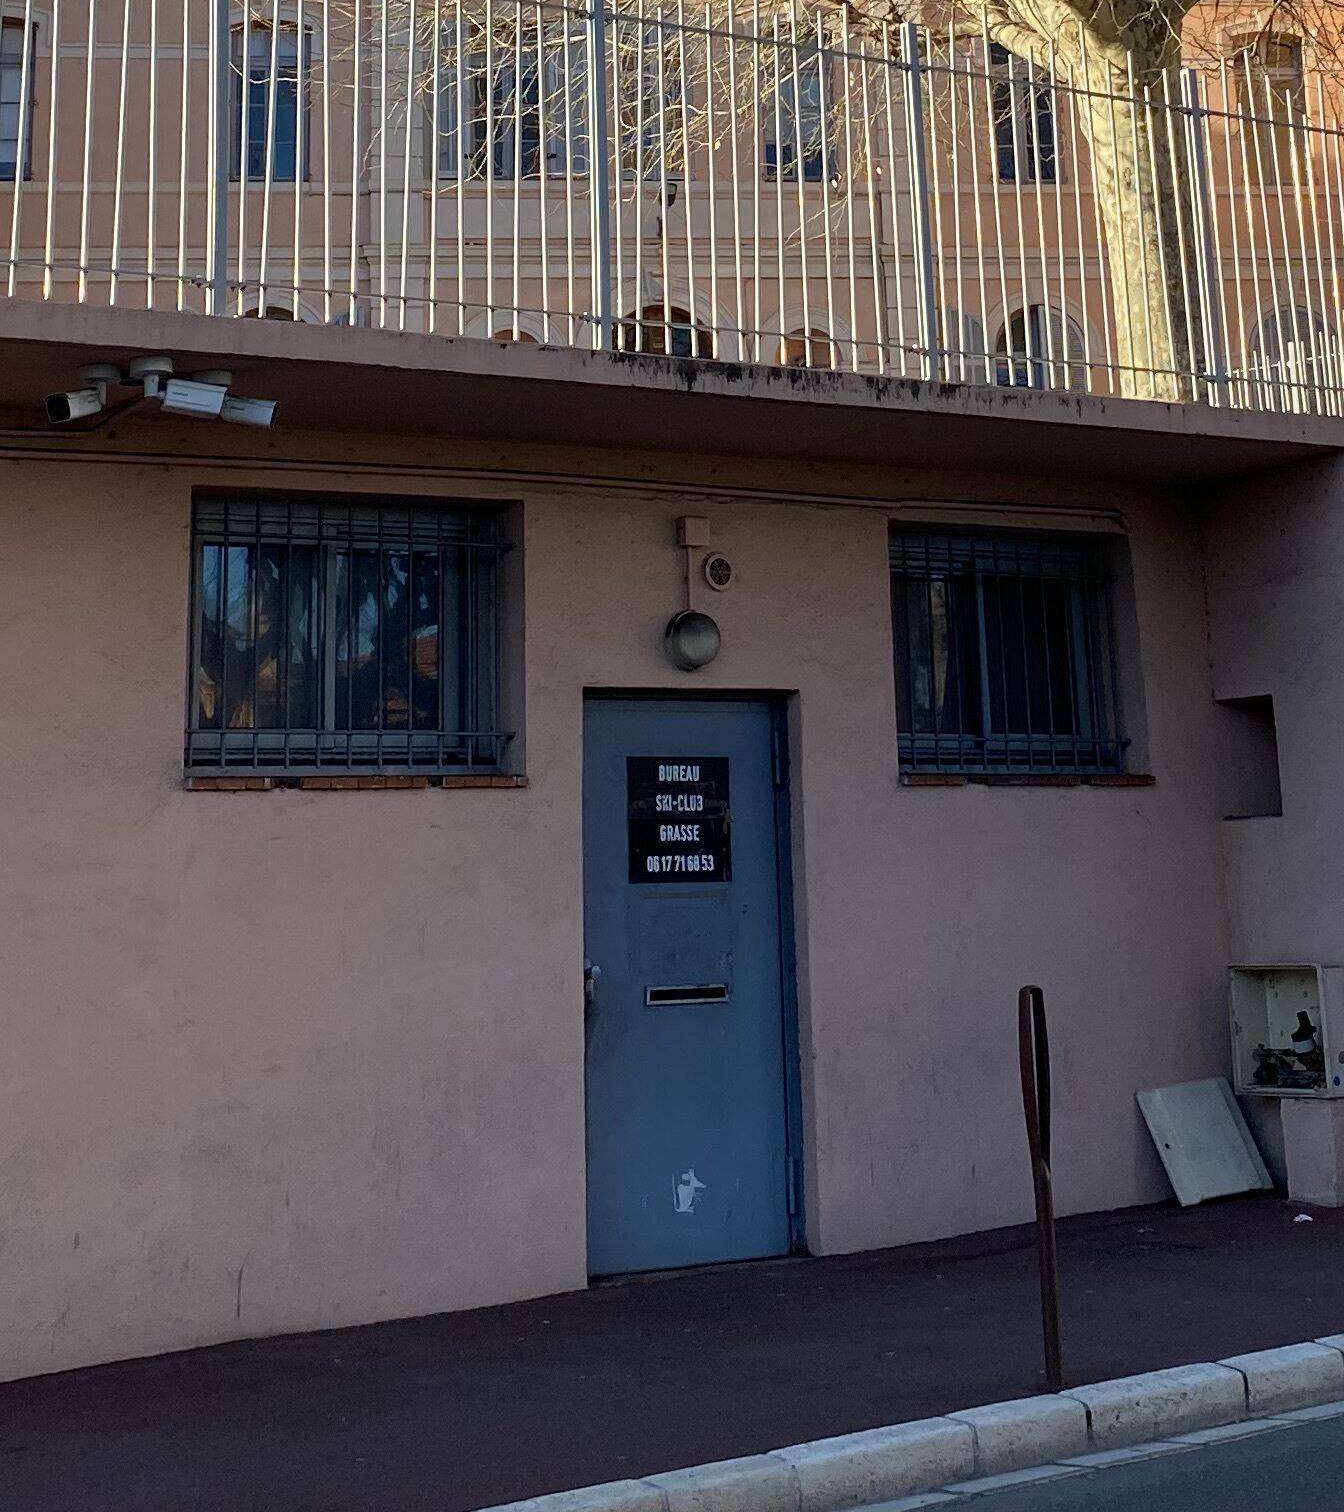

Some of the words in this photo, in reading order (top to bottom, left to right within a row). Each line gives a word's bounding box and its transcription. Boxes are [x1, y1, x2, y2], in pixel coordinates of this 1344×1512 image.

[658, 764, 700, 782] BUREAU
[655, 794, 704, 812] SKI-CLUB
[659, 824, 701, 842] GRASSE
